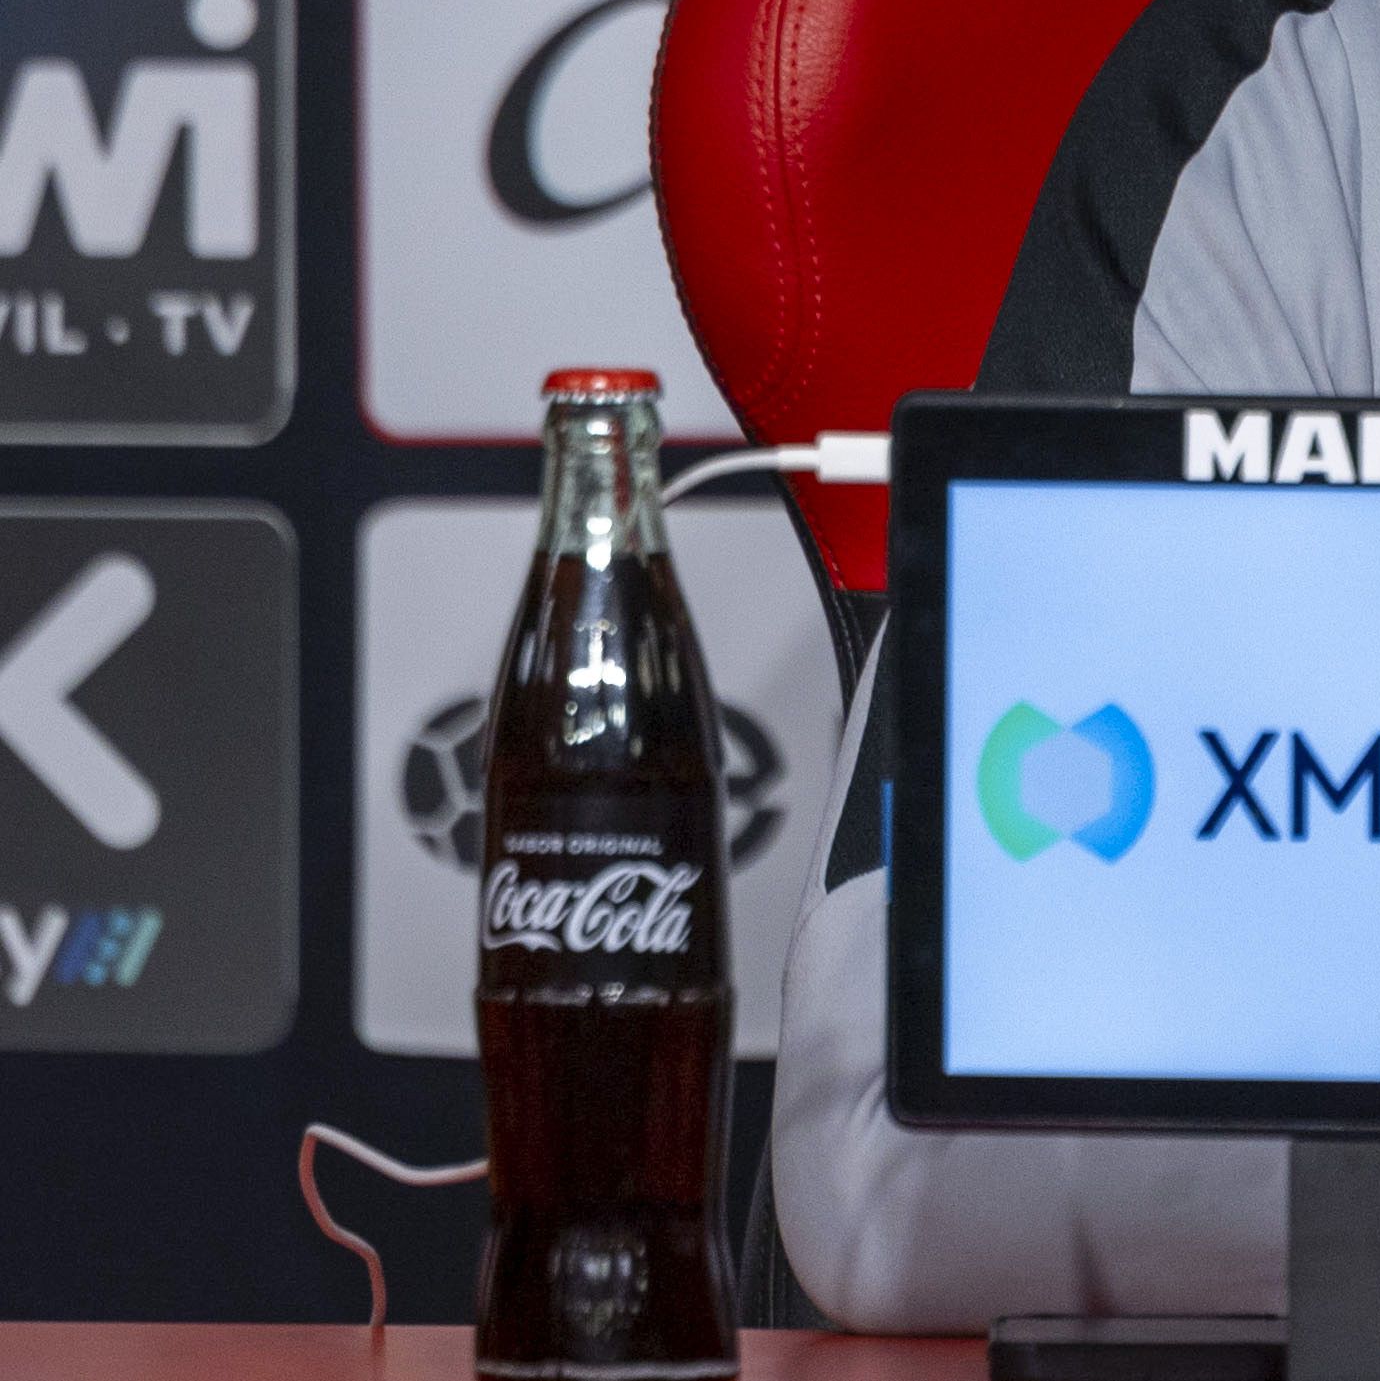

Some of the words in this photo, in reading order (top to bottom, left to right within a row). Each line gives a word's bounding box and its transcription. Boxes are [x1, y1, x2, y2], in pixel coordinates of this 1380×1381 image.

[152, 292, 255, 356] TV
[566, 832, 663, 856] ORIGINAL
[482, 860, 703, 953] Coca-Cola
